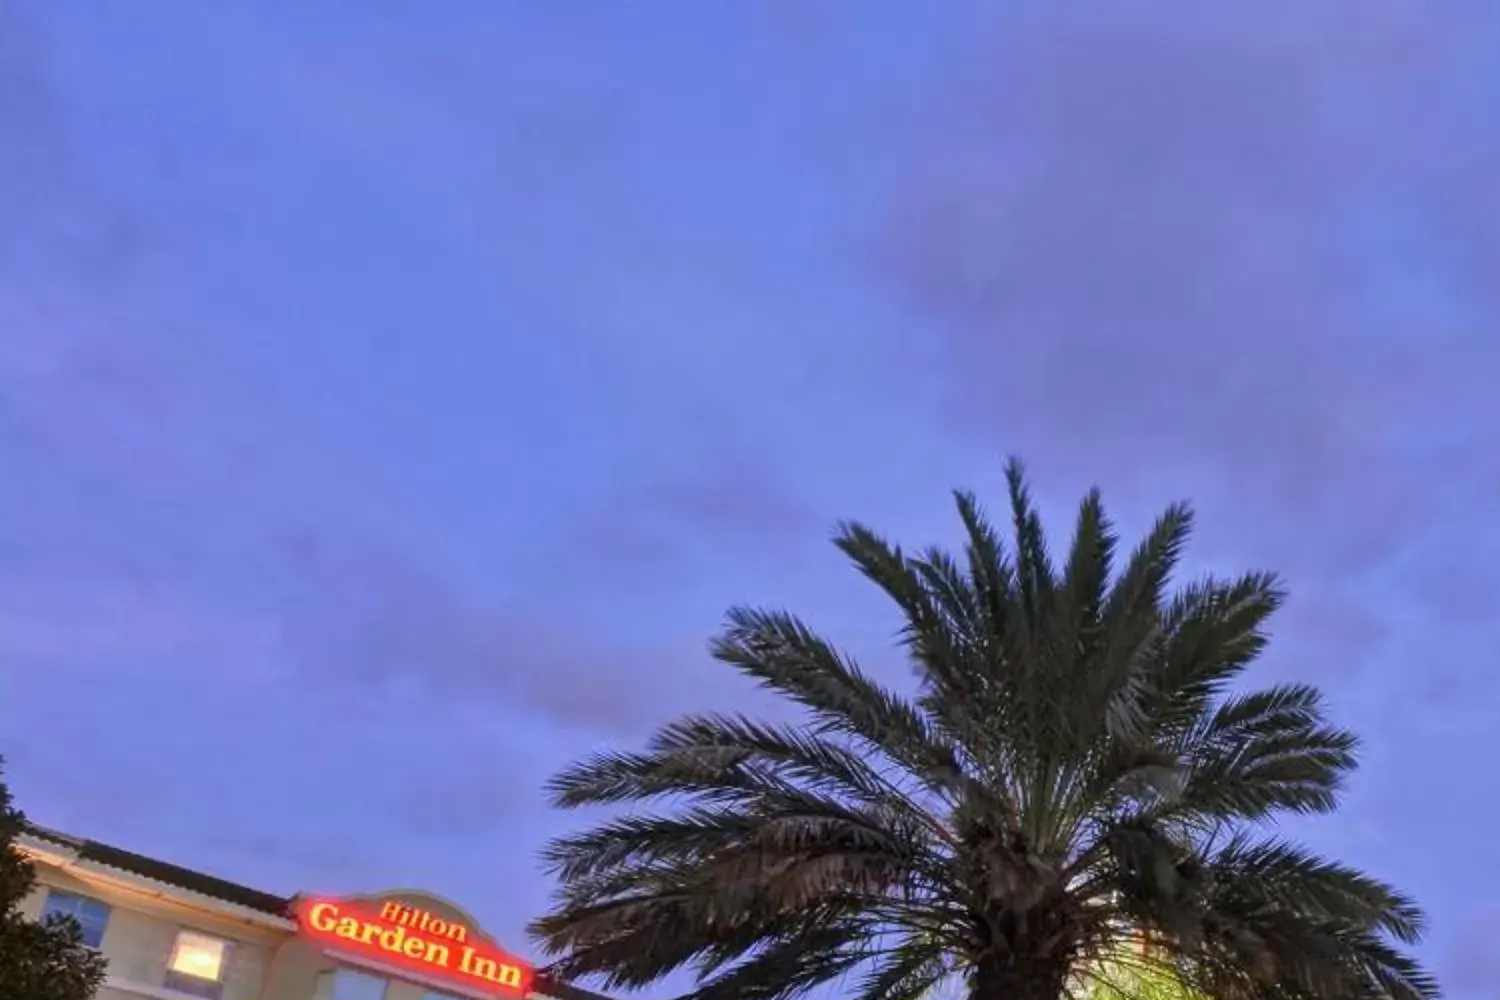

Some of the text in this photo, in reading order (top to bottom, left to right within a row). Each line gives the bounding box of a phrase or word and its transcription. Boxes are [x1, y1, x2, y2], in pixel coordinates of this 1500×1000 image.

[308, 902, 522, 988] Garden Inn
[380, 901, 467, 942] Hilton
